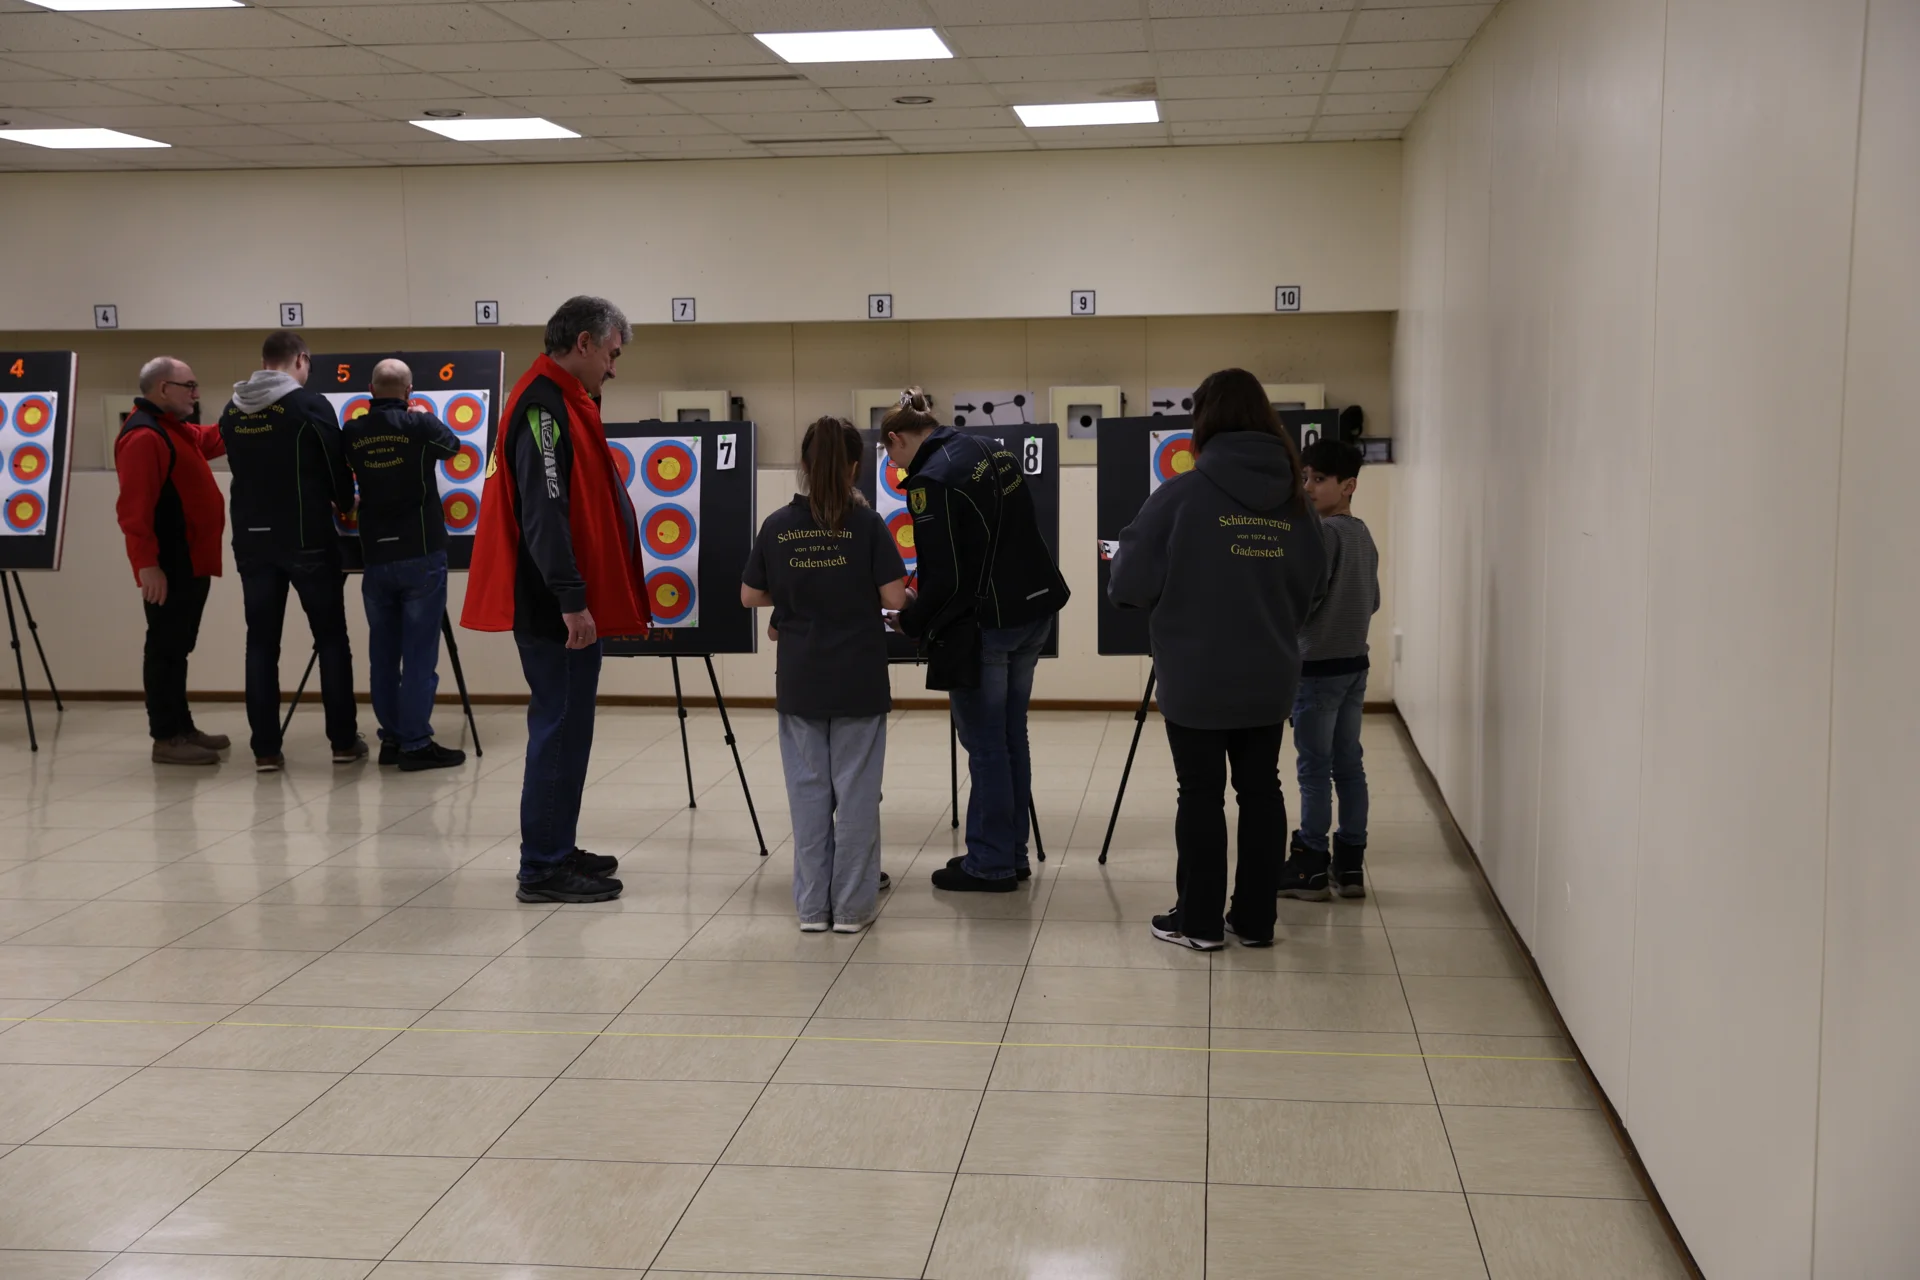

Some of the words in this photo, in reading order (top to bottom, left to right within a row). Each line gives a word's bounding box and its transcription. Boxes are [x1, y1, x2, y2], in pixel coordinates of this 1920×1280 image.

[1080, 296, 1087, 310] 9
[1281, 291, 1295, 305] 10
[483, 305, 490, 319] 6
[680, 303, 687, 316] 7
[877, 299, 884, 313] 8
[102, 310, 109, 323] 4
[288, 307, 295, 321] 5
[9, 357, 25, 379] 4
[337, 363, 351, 382] 5
[438, 362, 455, 381] 6
[352, 434, 410, 450] Schützenverein
[720, 442, 732, 465] 7
[1025, 443, 1038, 473] 8
[363, 456, 405, 469] Gadenstedt
[1218, 514, 1292, 531] Schützenverein
[777, 528, 853, 544] Schützenveein
[1230, 543, 1285, 558] Gadenstedt
[789, 555, 847, 568] Gadenstedt
